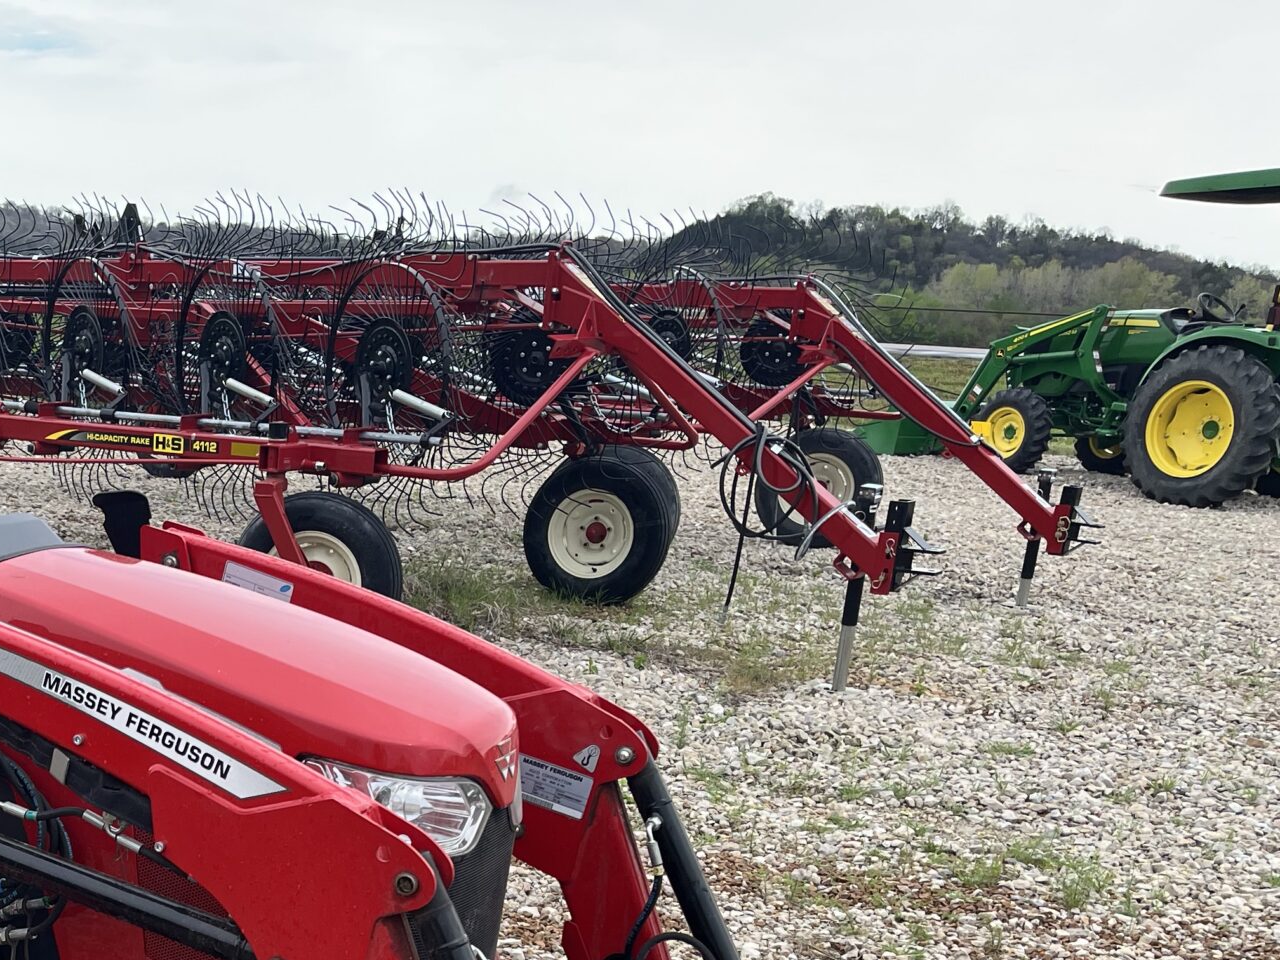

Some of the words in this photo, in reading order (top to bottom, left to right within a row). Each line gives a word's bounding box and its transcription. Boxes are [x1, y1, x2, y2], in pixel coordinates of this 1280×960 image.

[86, 432, 128, 444] HI-CAPACITY
[130, 435, 150, 445] RAKE
[192, 440, 217, 452] 4112
[42, 672, 122, 721] MASSEY
[125, 712, 232, 780] FERGUSON
[523, 758, 549, 770] MASSEY
[550, 766, 584, 782] FERGUSON
